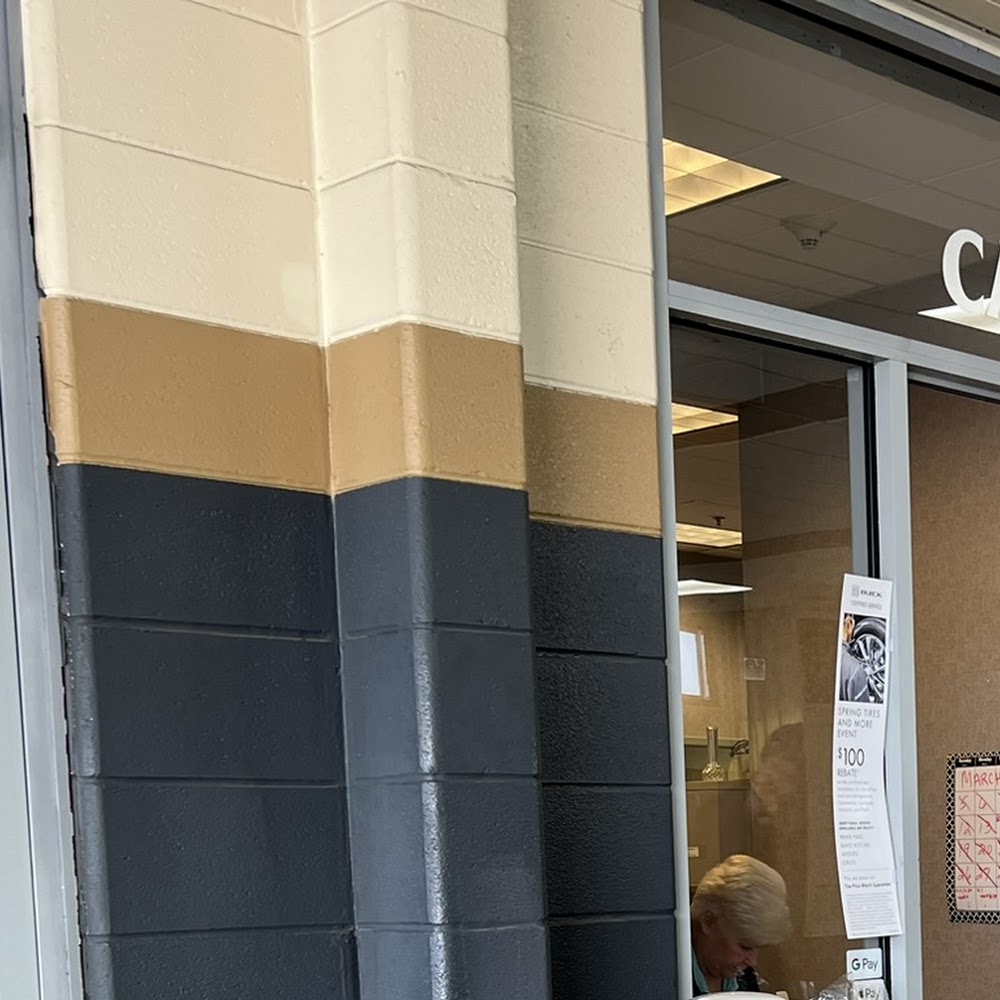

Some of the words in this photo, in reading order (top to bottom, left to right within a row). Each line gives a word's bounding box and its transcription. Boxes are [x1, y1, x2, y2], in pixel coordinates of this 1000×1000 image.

[838, 707, 862, 717] SPRING
[863, 708, 880, 718] TIRES
[838, 719, 852, 728] AND
[854, 719, 873, 729] MORE
[837, 729, 857, 738] EVENT
[838, 747, 865, 767] $100
[862, 957, 879, 972] Pay
